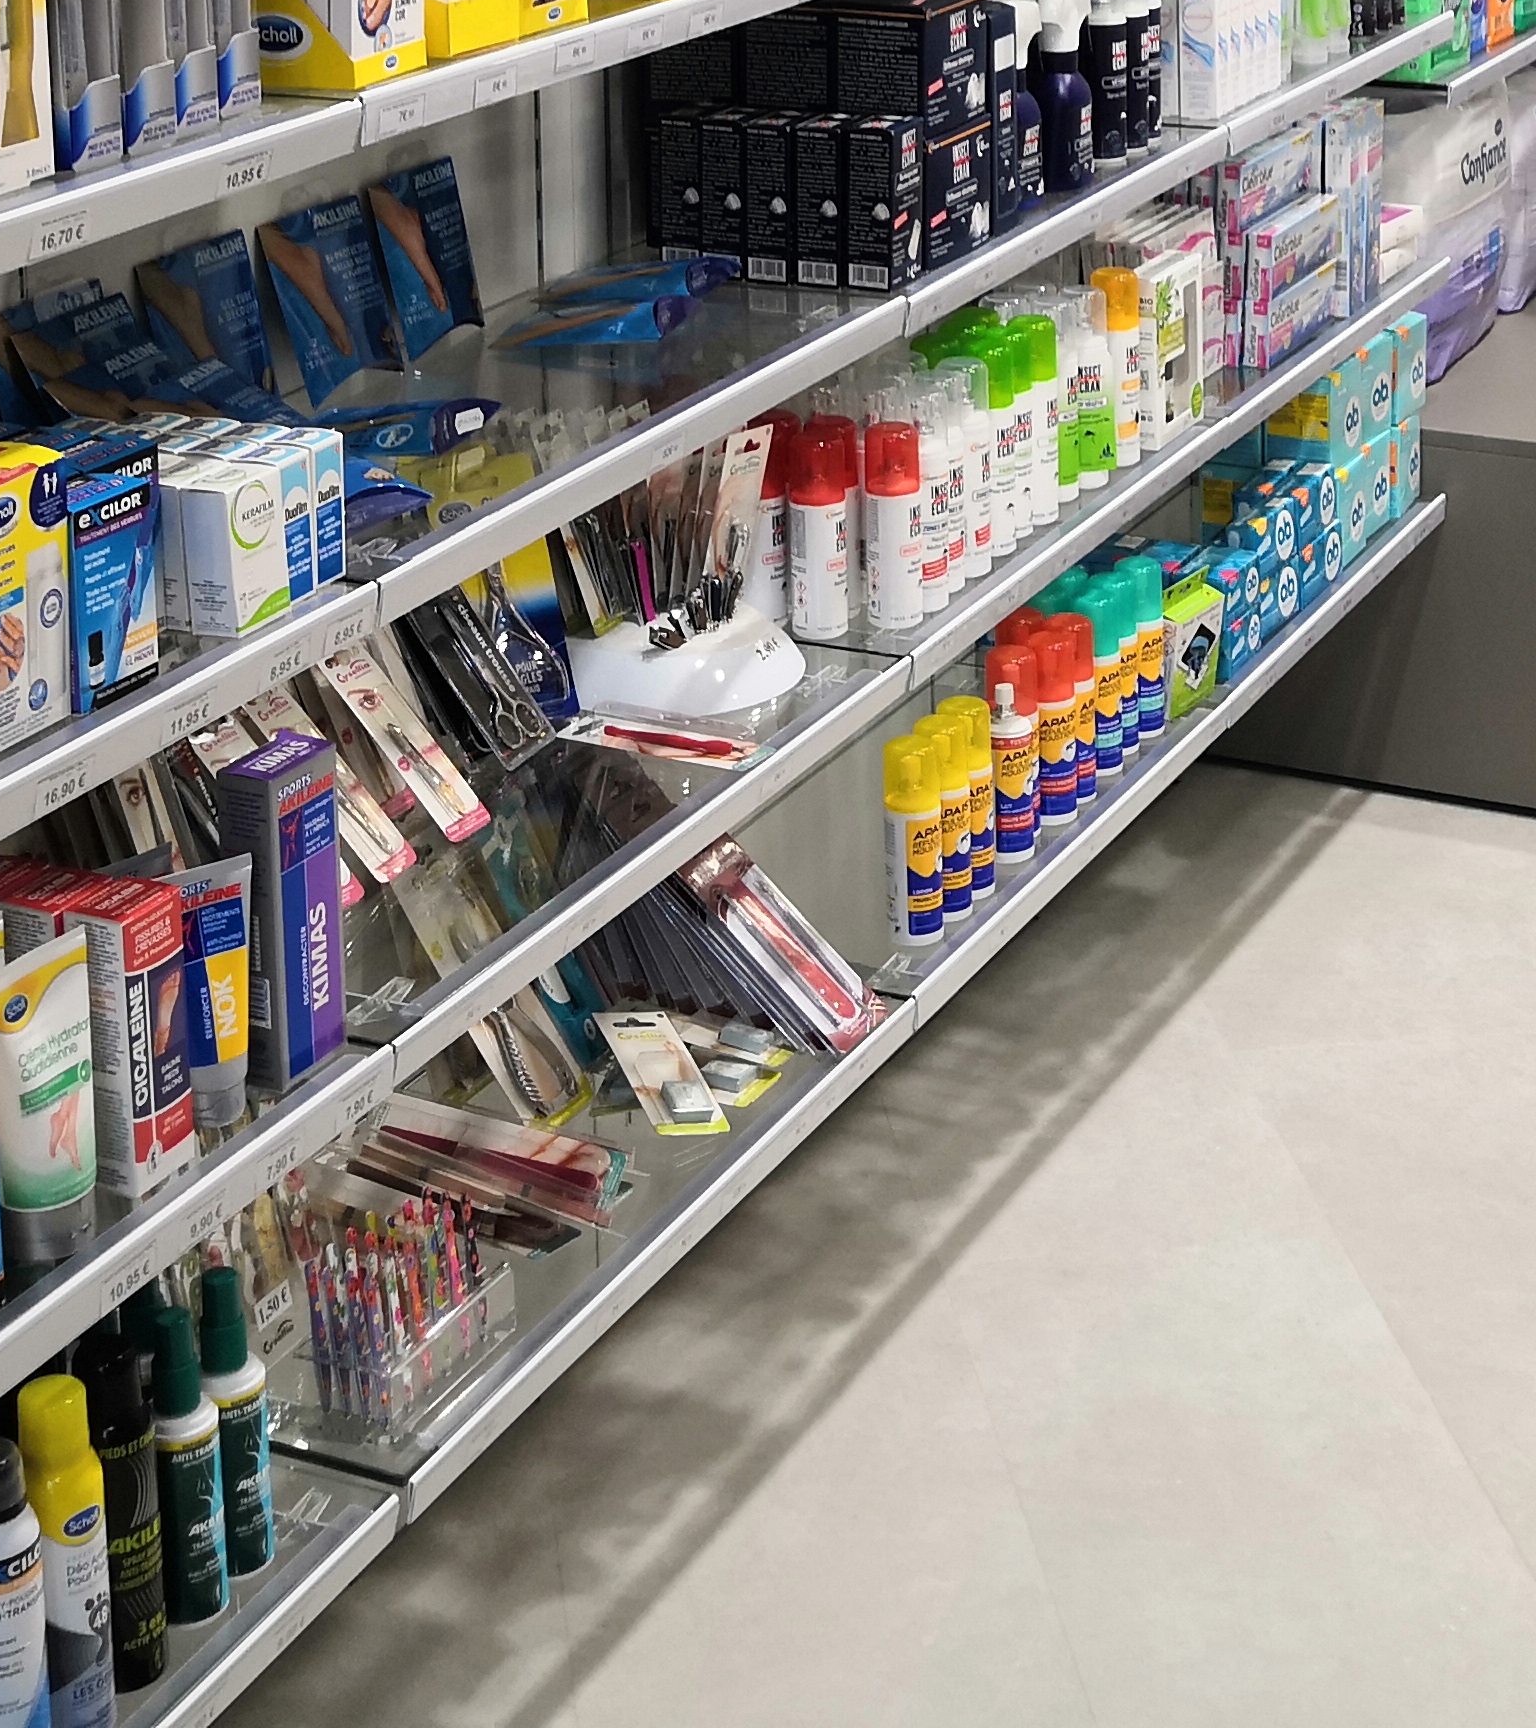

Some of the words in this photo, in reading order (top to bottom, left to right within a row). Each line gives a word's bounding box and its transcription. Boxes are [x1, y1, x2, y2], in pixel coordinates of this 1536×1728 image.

[224, 169, 255, 189] 10,95
[254, 167, 264, 183] €
[1460, 141, 1508, 187] Confiance
[38, 227, 74, 251] 16,70
[72, 223, 86, 244] €
[78, 489, 146, 530] eXCILOR
[317, 485, 341, 503] DuoFilm
[240, 498, 276, 522] KERAFILM
[284, 501, 309, 522] DuoFilm
[334, 623, 356, 645] 8,95
[355, 618, 364, 635] €
[269, 658, 293, 682] 8,95
[292, 651, 302, 667] €
[169, 707, 197, 734] 11,95
[197, 704, 209, 720] €
[250, 738, 311, 773] KIMAS
[42, 776, 78, 807] 16,90
[76, 773, 87, 791] €
[277, 774, 312, 802] SPORTS
[302, 925, 310, 1007] DECONTRACTER
[313, 901, 328, 1010] KIMAS
[6, 995, 28, 1018] Scholl
[219, 973, 245, 1039] NOK
[136, 979, 147, 1107] CICALEINE
[21, 1040, 79, 1083] Quotidienne
[107, 1269, 142, 1303] 10,95
[140, 1257, 151, 1282] €
[67, 1506, 101, 1535] Scholl
